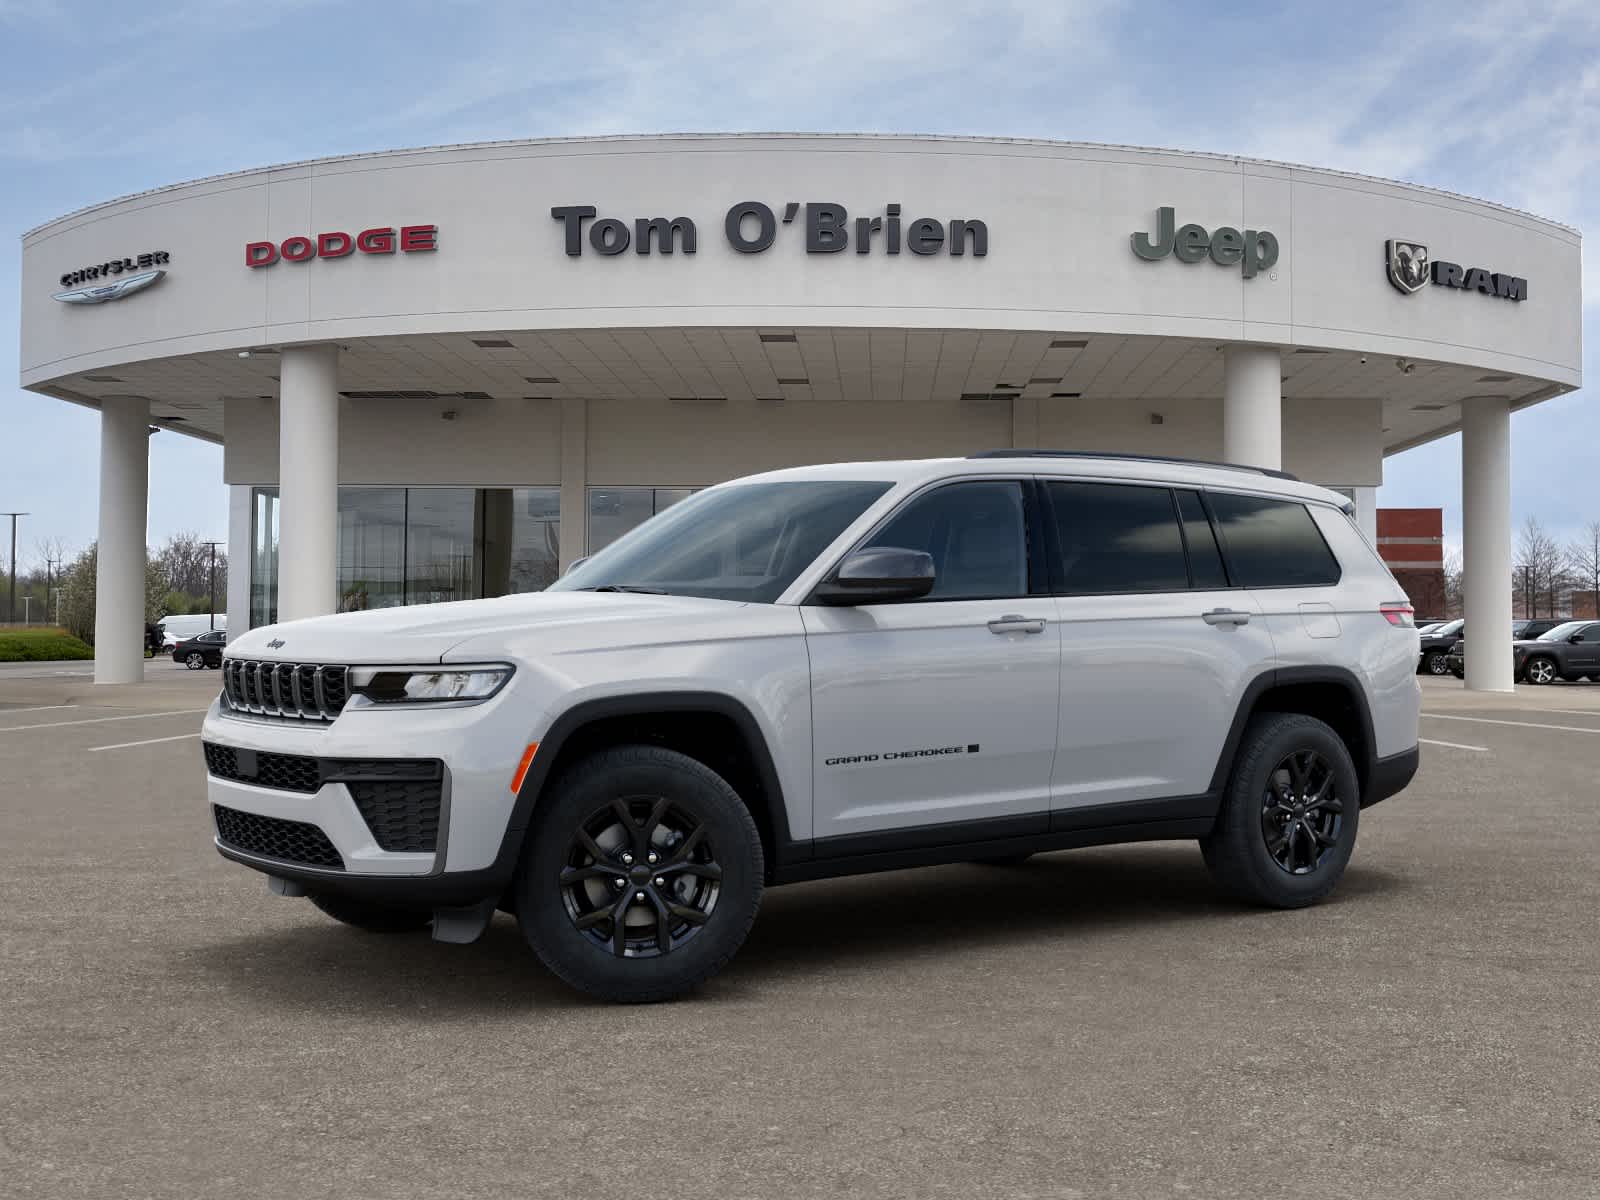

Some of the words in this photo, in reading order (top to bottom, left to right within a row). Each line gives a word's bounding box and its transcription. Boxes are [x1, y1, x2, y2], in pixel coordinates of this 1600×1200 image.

[245, 224, 438, 268] DODGE
[551, 206, 697, 256] Tom
[725, 201, 988, 256] O’Brien
[1130, 207, 1280, 279] Jeep
[60, 249, 171, 287] CHRYSLER
[1430, 260, 1528, 302] RAM
[825, 753, 879, 766] GRAND
[883, 746, 964, 760] CHEROKEE
